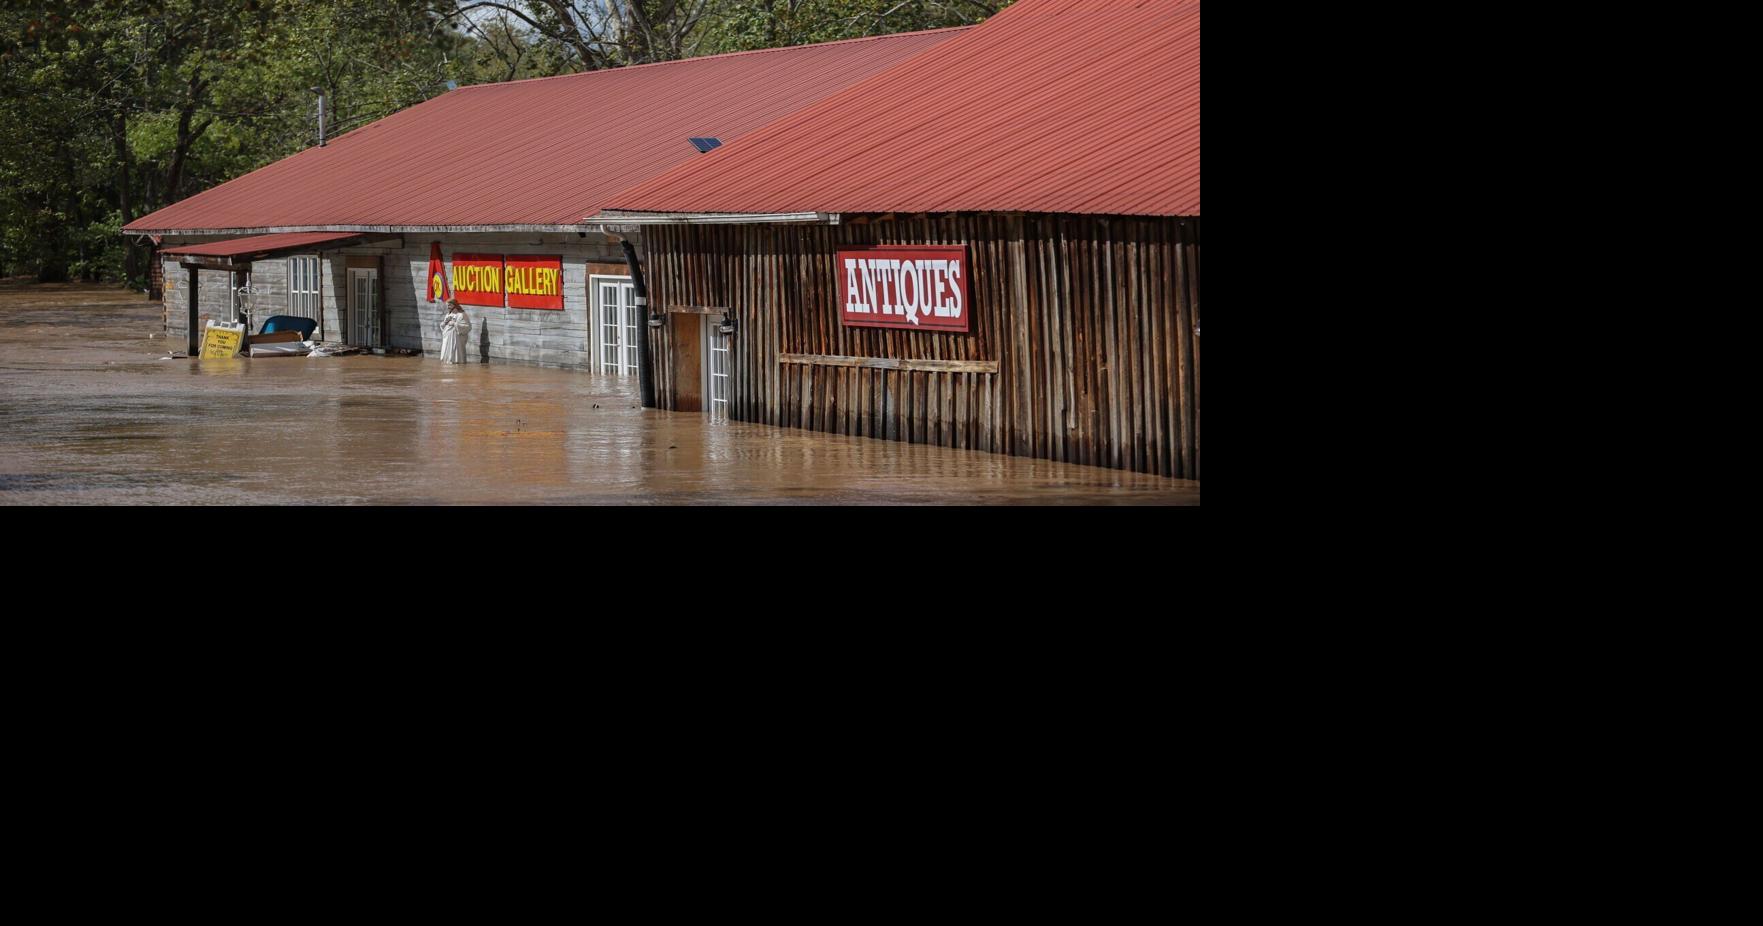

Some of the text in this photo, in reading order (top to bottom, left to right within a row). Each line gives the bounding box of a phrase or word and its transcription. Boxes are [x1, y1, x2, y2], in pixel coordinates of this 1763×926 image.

[452, 265, 500, 293] AUCTION
[505, 265, 559, 296] GALLERY
[844, 258, 962, 326] ANTIQUES
